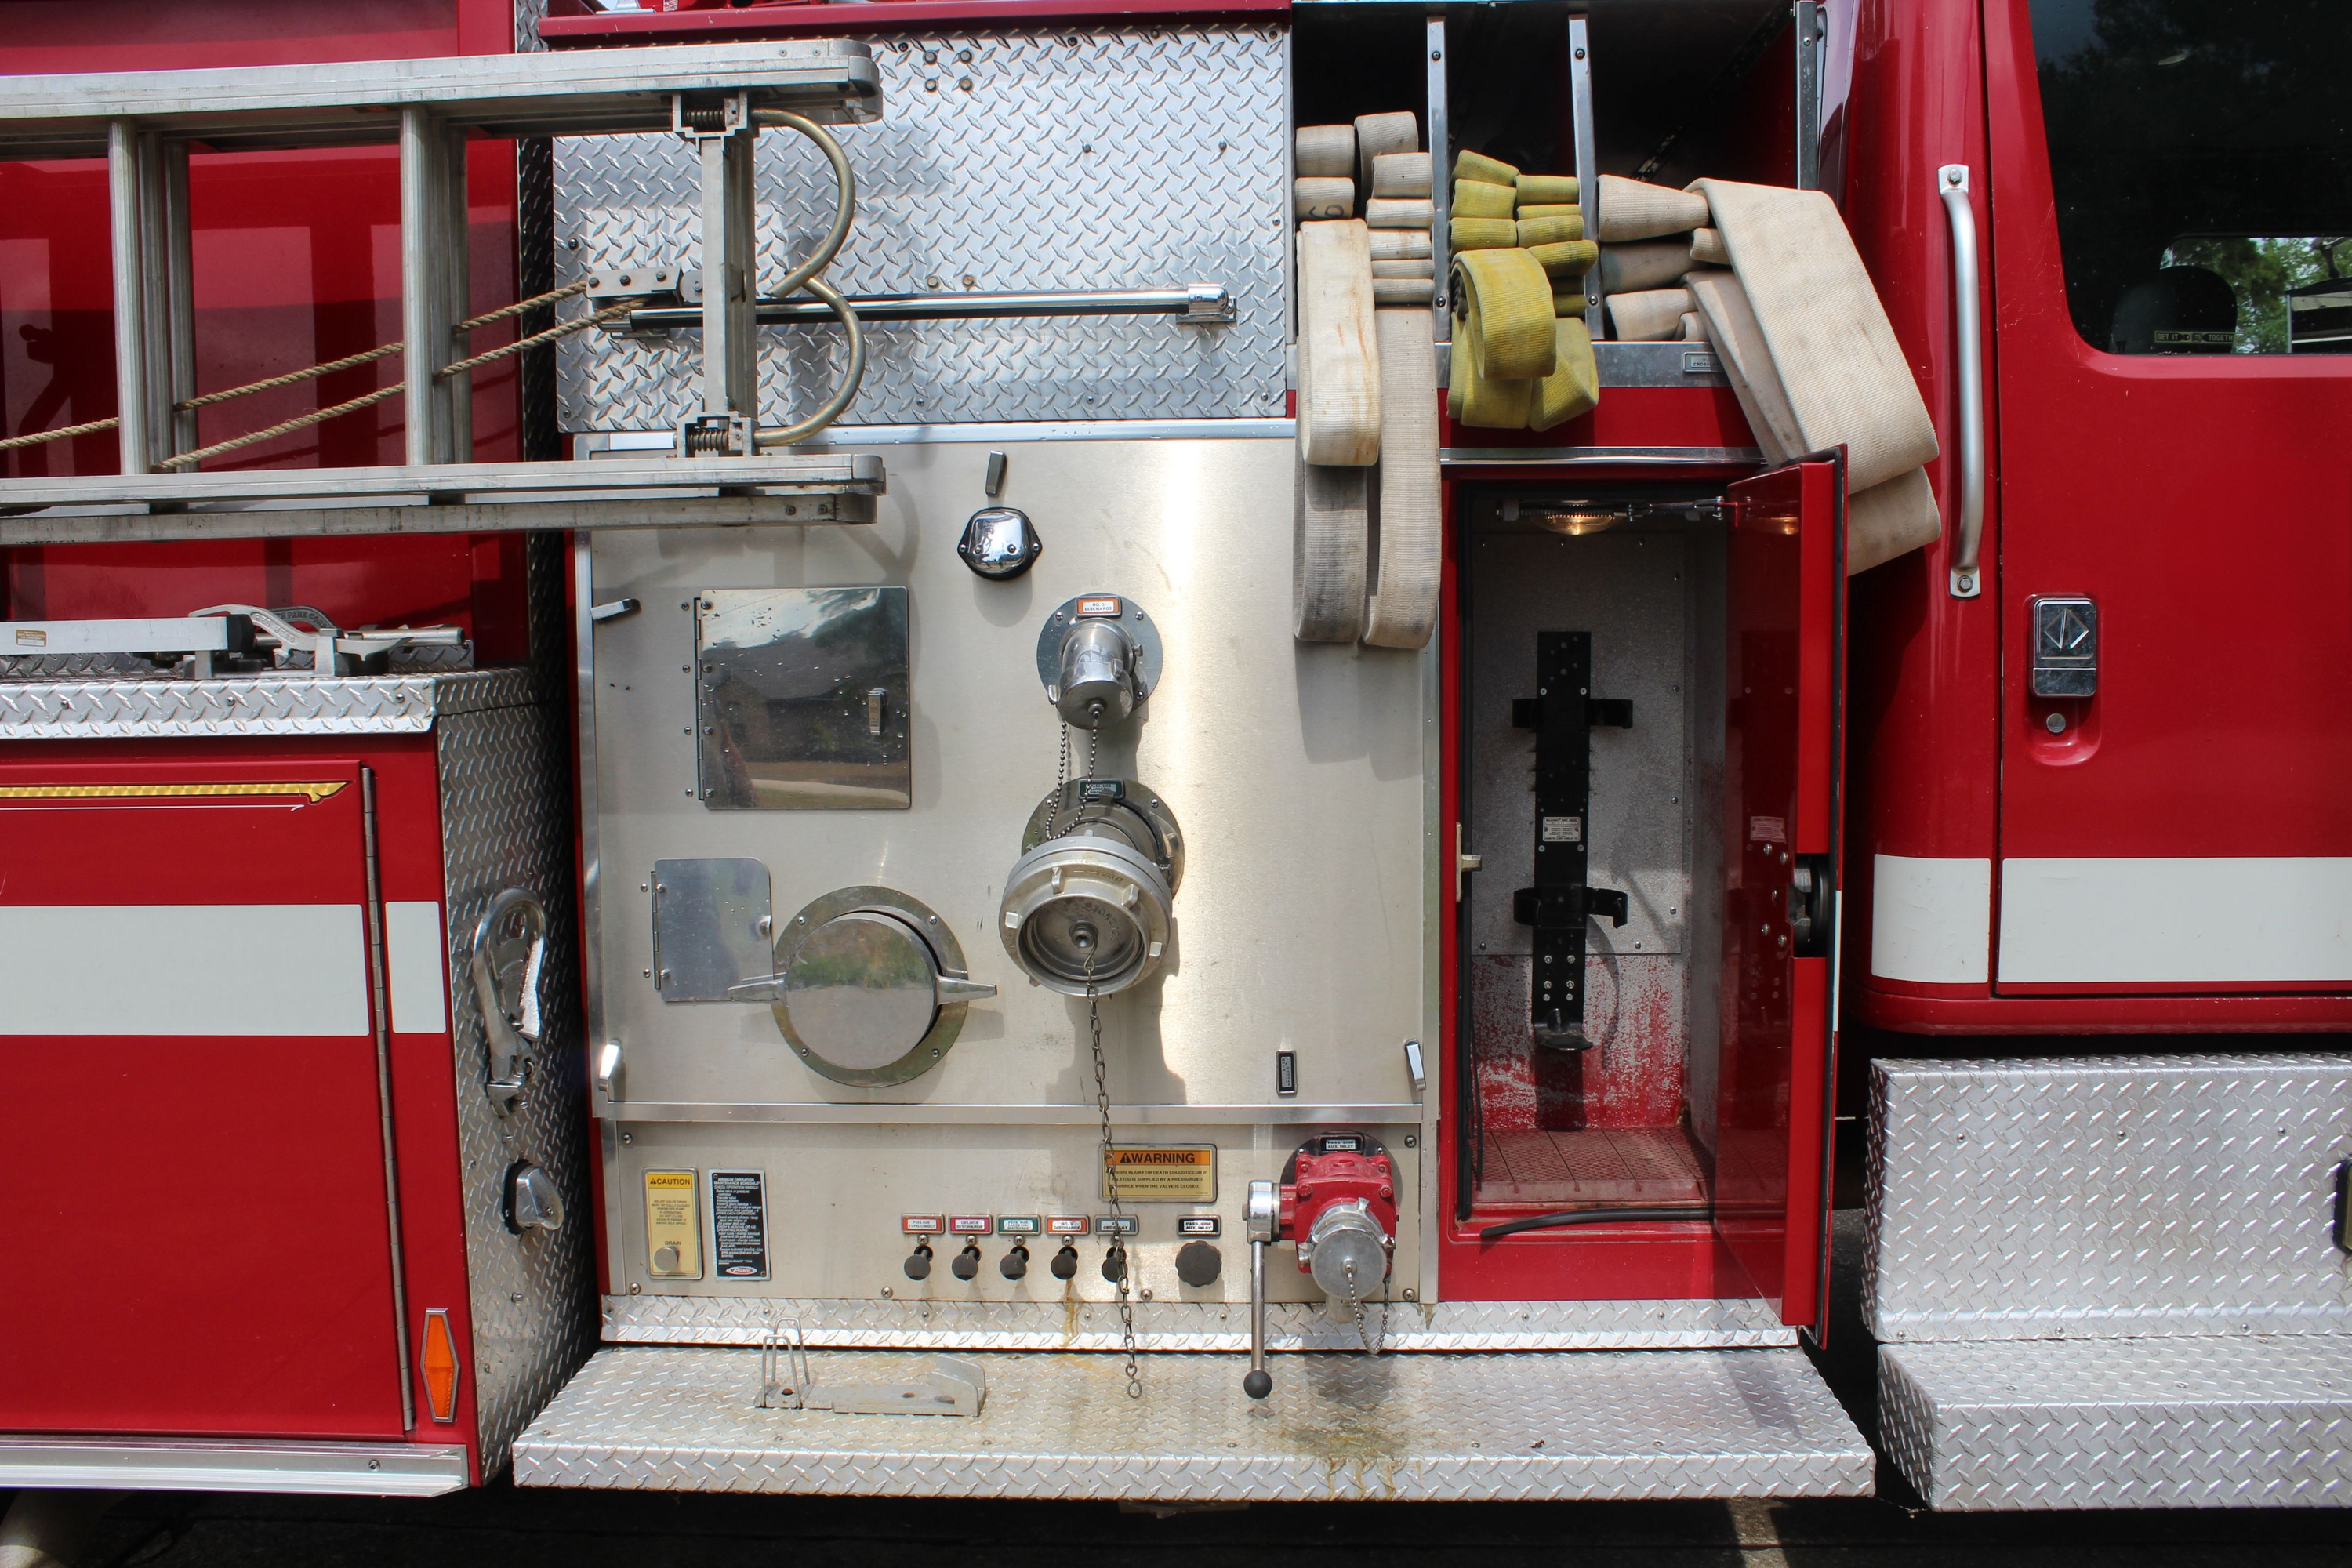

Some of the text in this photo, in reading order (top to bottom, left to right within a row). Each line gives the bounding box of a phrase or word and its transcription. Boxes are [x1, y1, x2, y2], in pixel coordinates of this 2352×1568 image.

[288, 611, 308, 619] PARK
[255, 614, 270, 627] RED
[1132, 1153, 1195, 1163] WARNING
